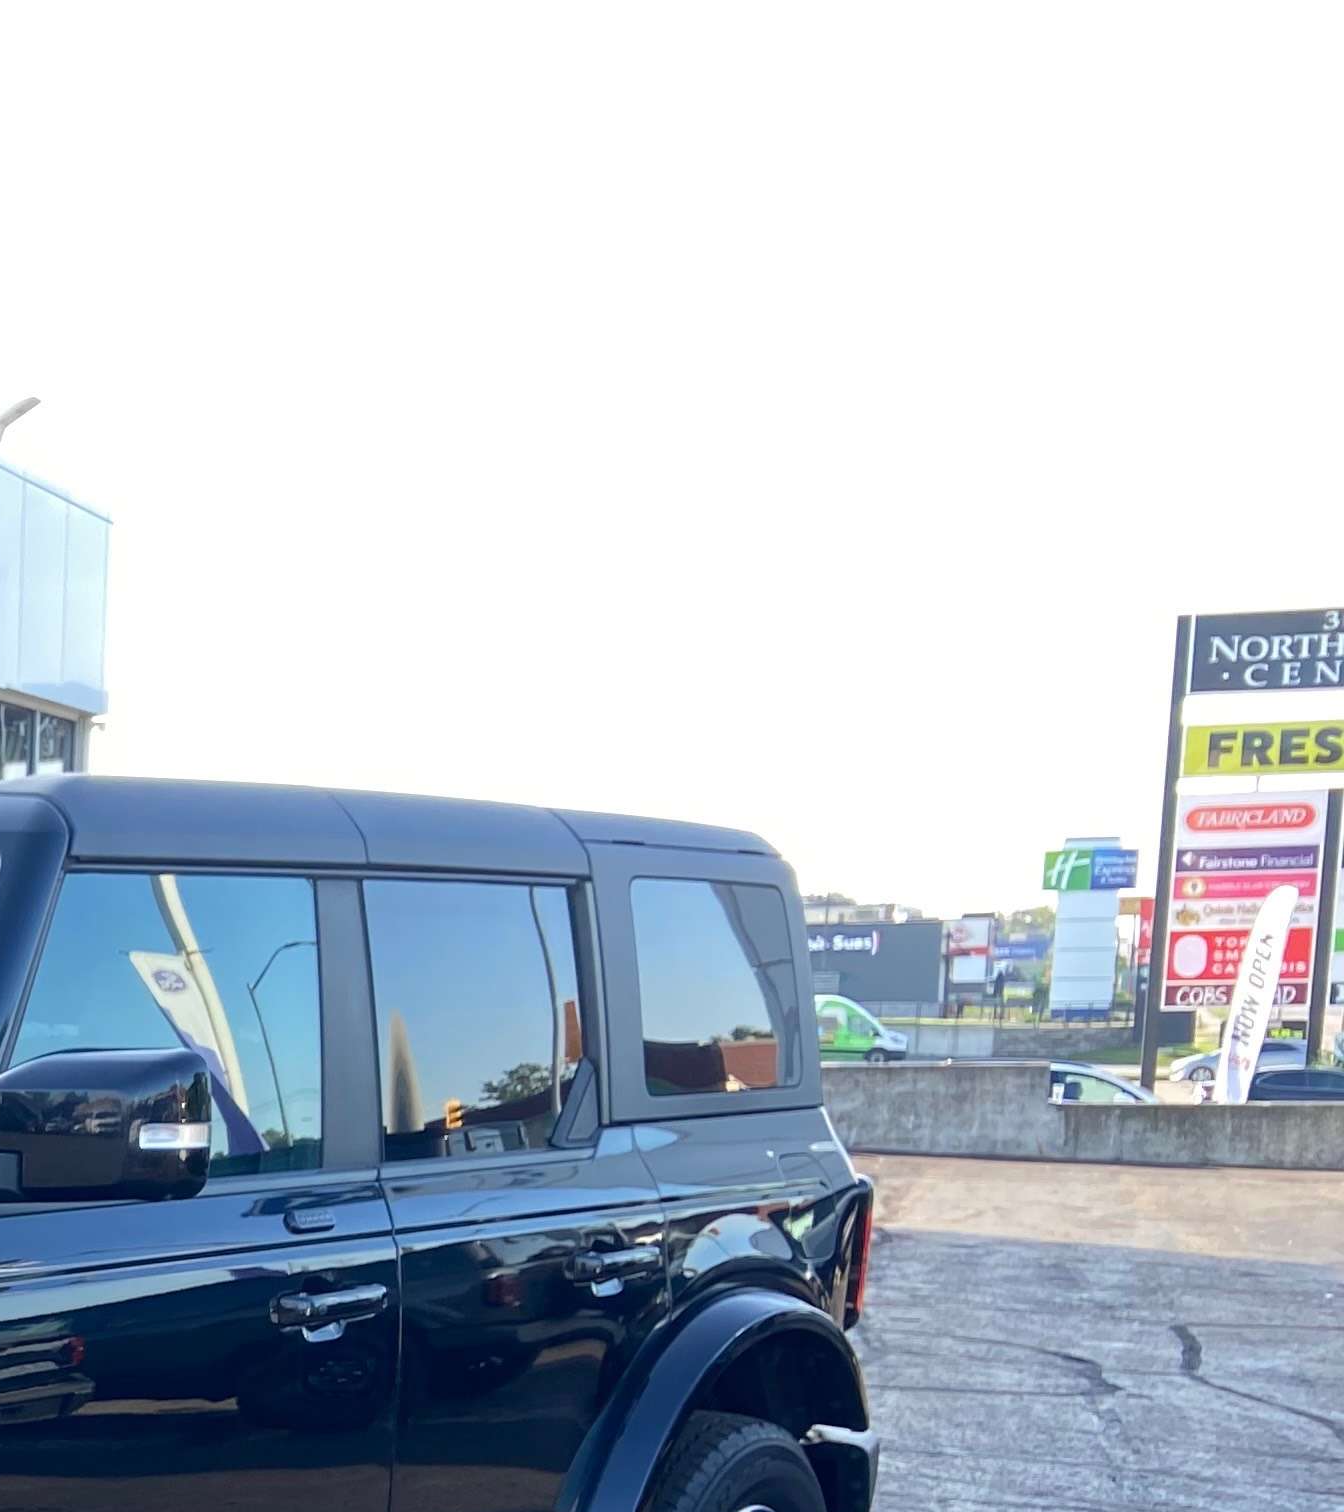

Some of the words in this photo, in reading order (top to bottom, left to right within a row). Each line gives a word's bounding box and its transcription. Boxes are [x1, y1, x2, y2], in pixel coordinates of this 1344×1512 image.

[1207, 727, 1344, 769] FRES
[1199, 854, 1259, 870] Fairstone
[1261, 852, 1314, 868] Financial
[1176, 984, 1229, 1005] COBS
